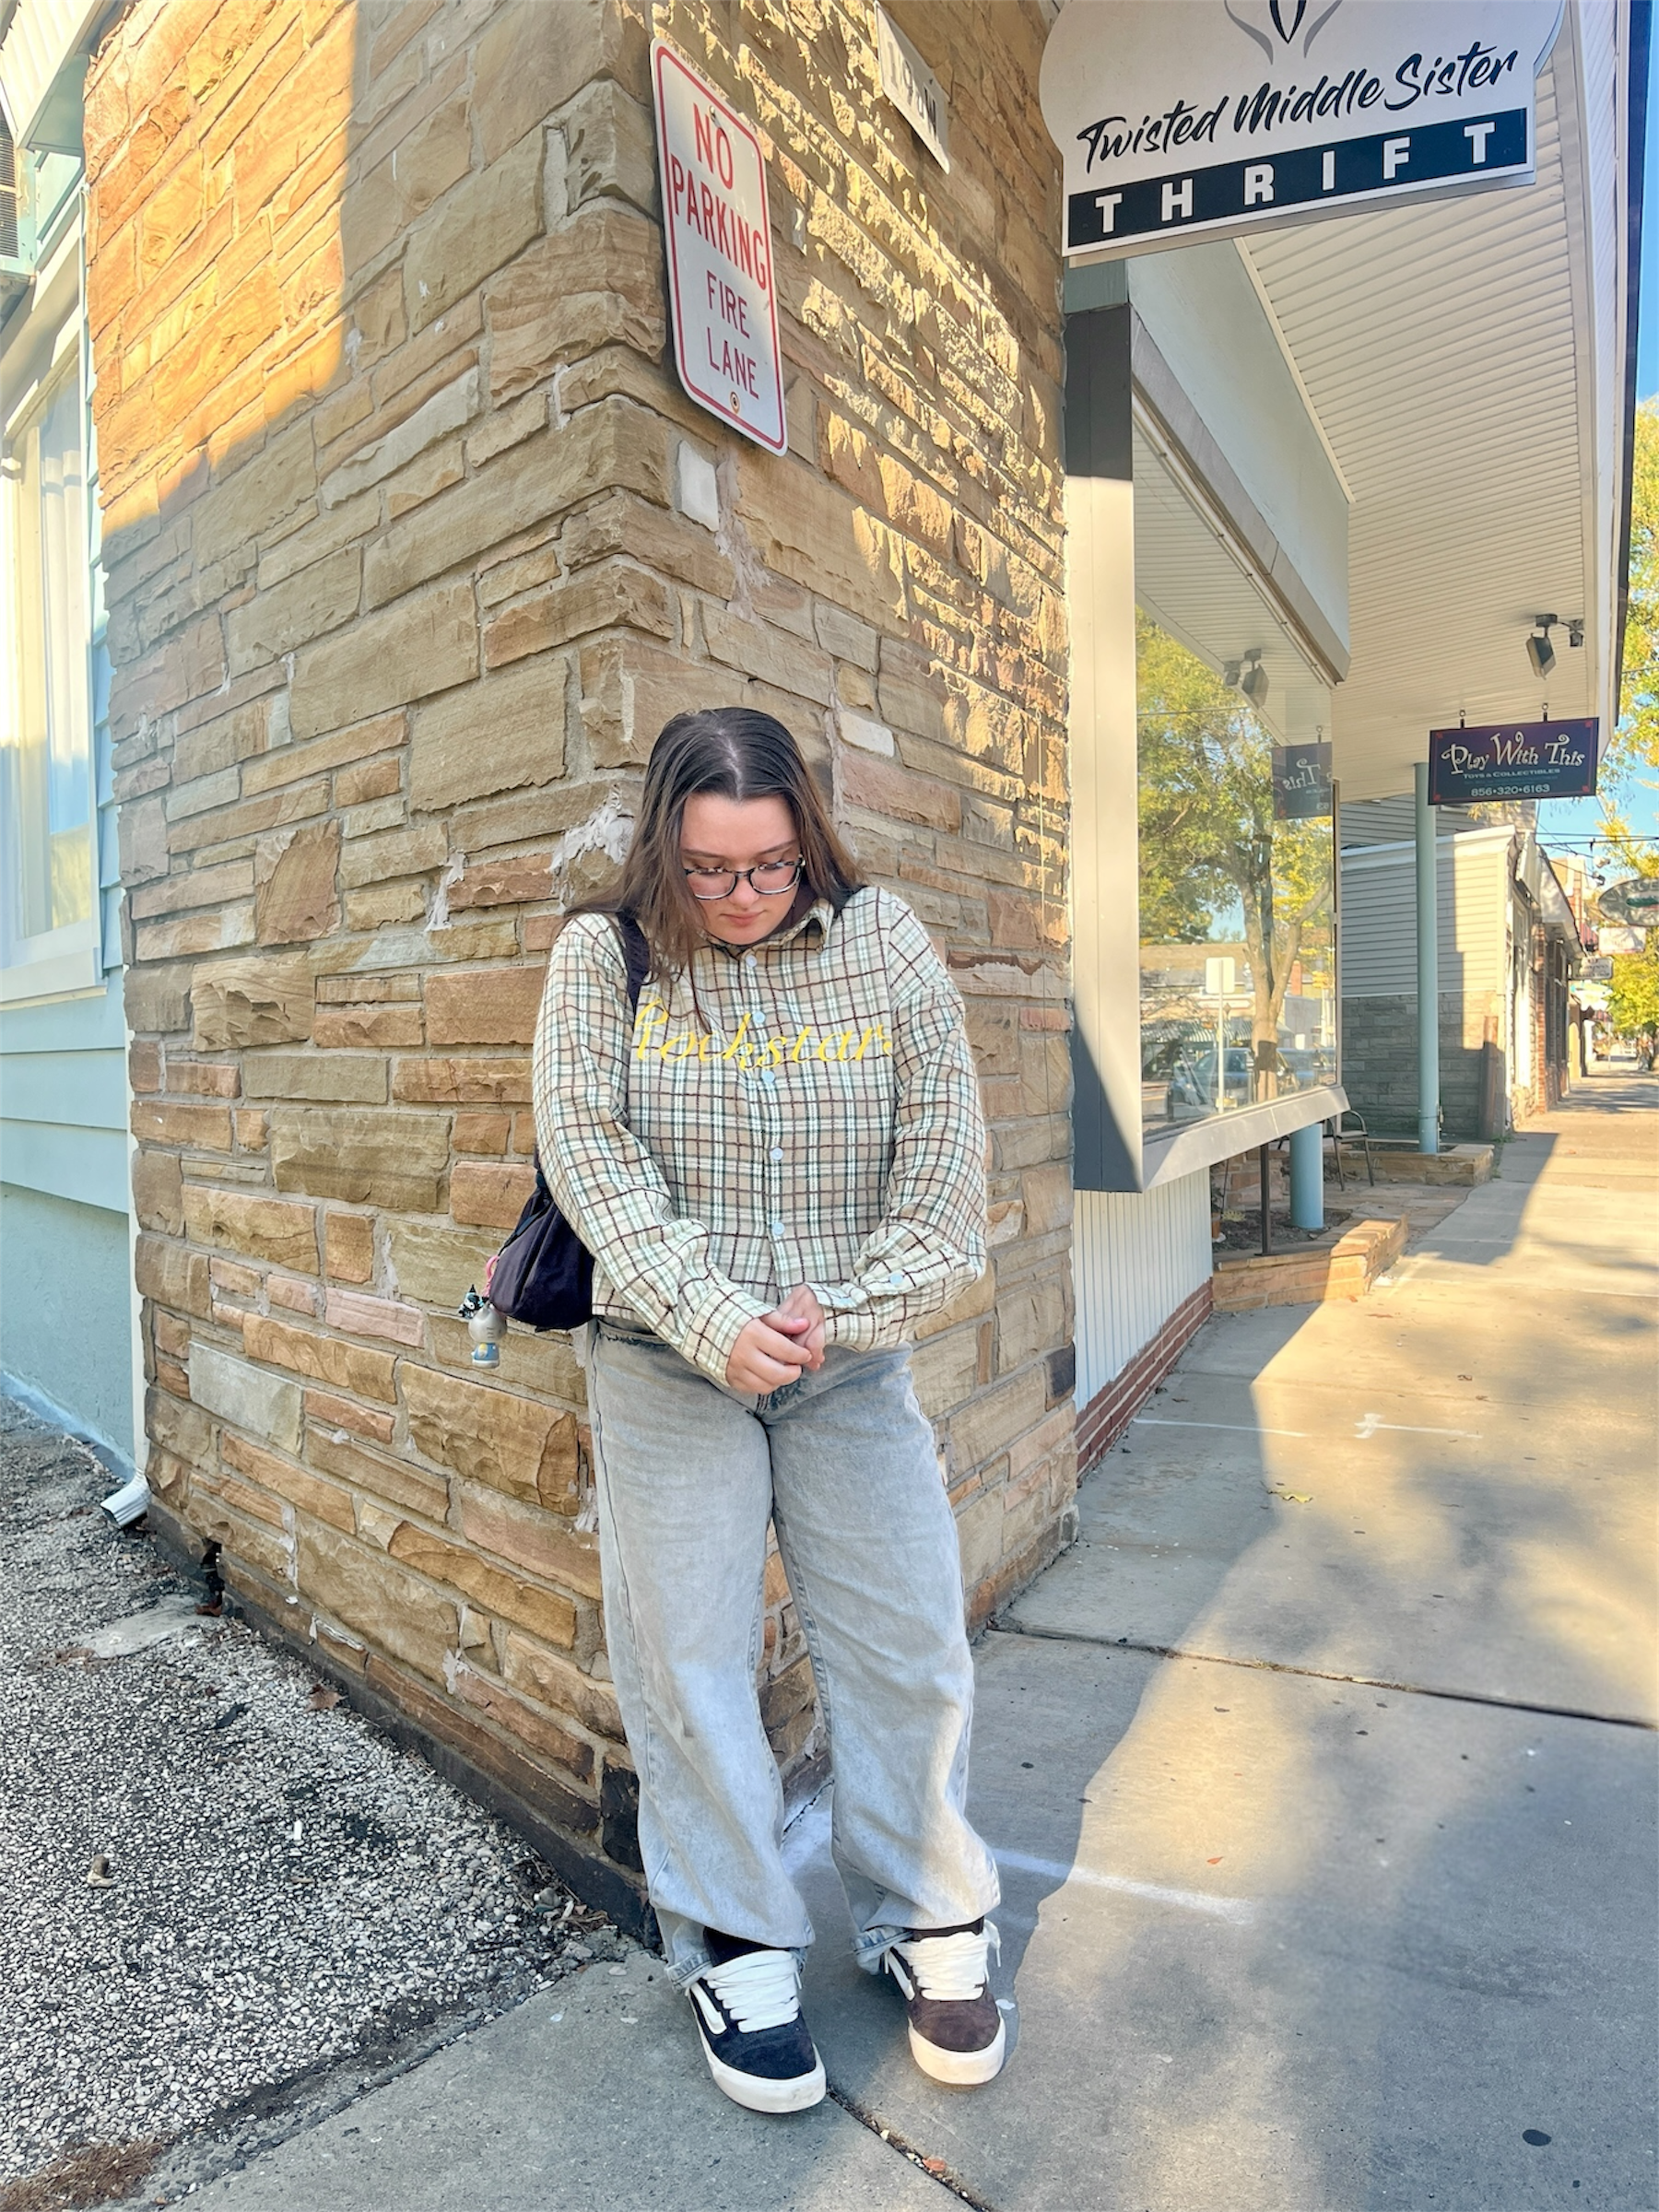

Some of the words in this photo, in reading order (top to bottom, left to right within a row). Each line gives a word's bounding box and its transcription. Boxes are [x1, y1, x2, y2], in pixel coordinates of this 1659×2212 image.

[693, 102, 734, 190] NO
[1077, 95, 1230, 175] Twisted
[1234, 69, 1384, 134] Middle
[1384, 41, 1518, 111] Sister
[1095, 122, 1496, 233] THRIFT
[671, 153, 767, 291] PARKING
[707, 270, 750, 339] FIRE
[707, 326, 759, 400] LANE
[1441, 743, 1490, 775] Play
[1489, 731, 1539, 766] With
[1544, 734, 1585, 767] This
